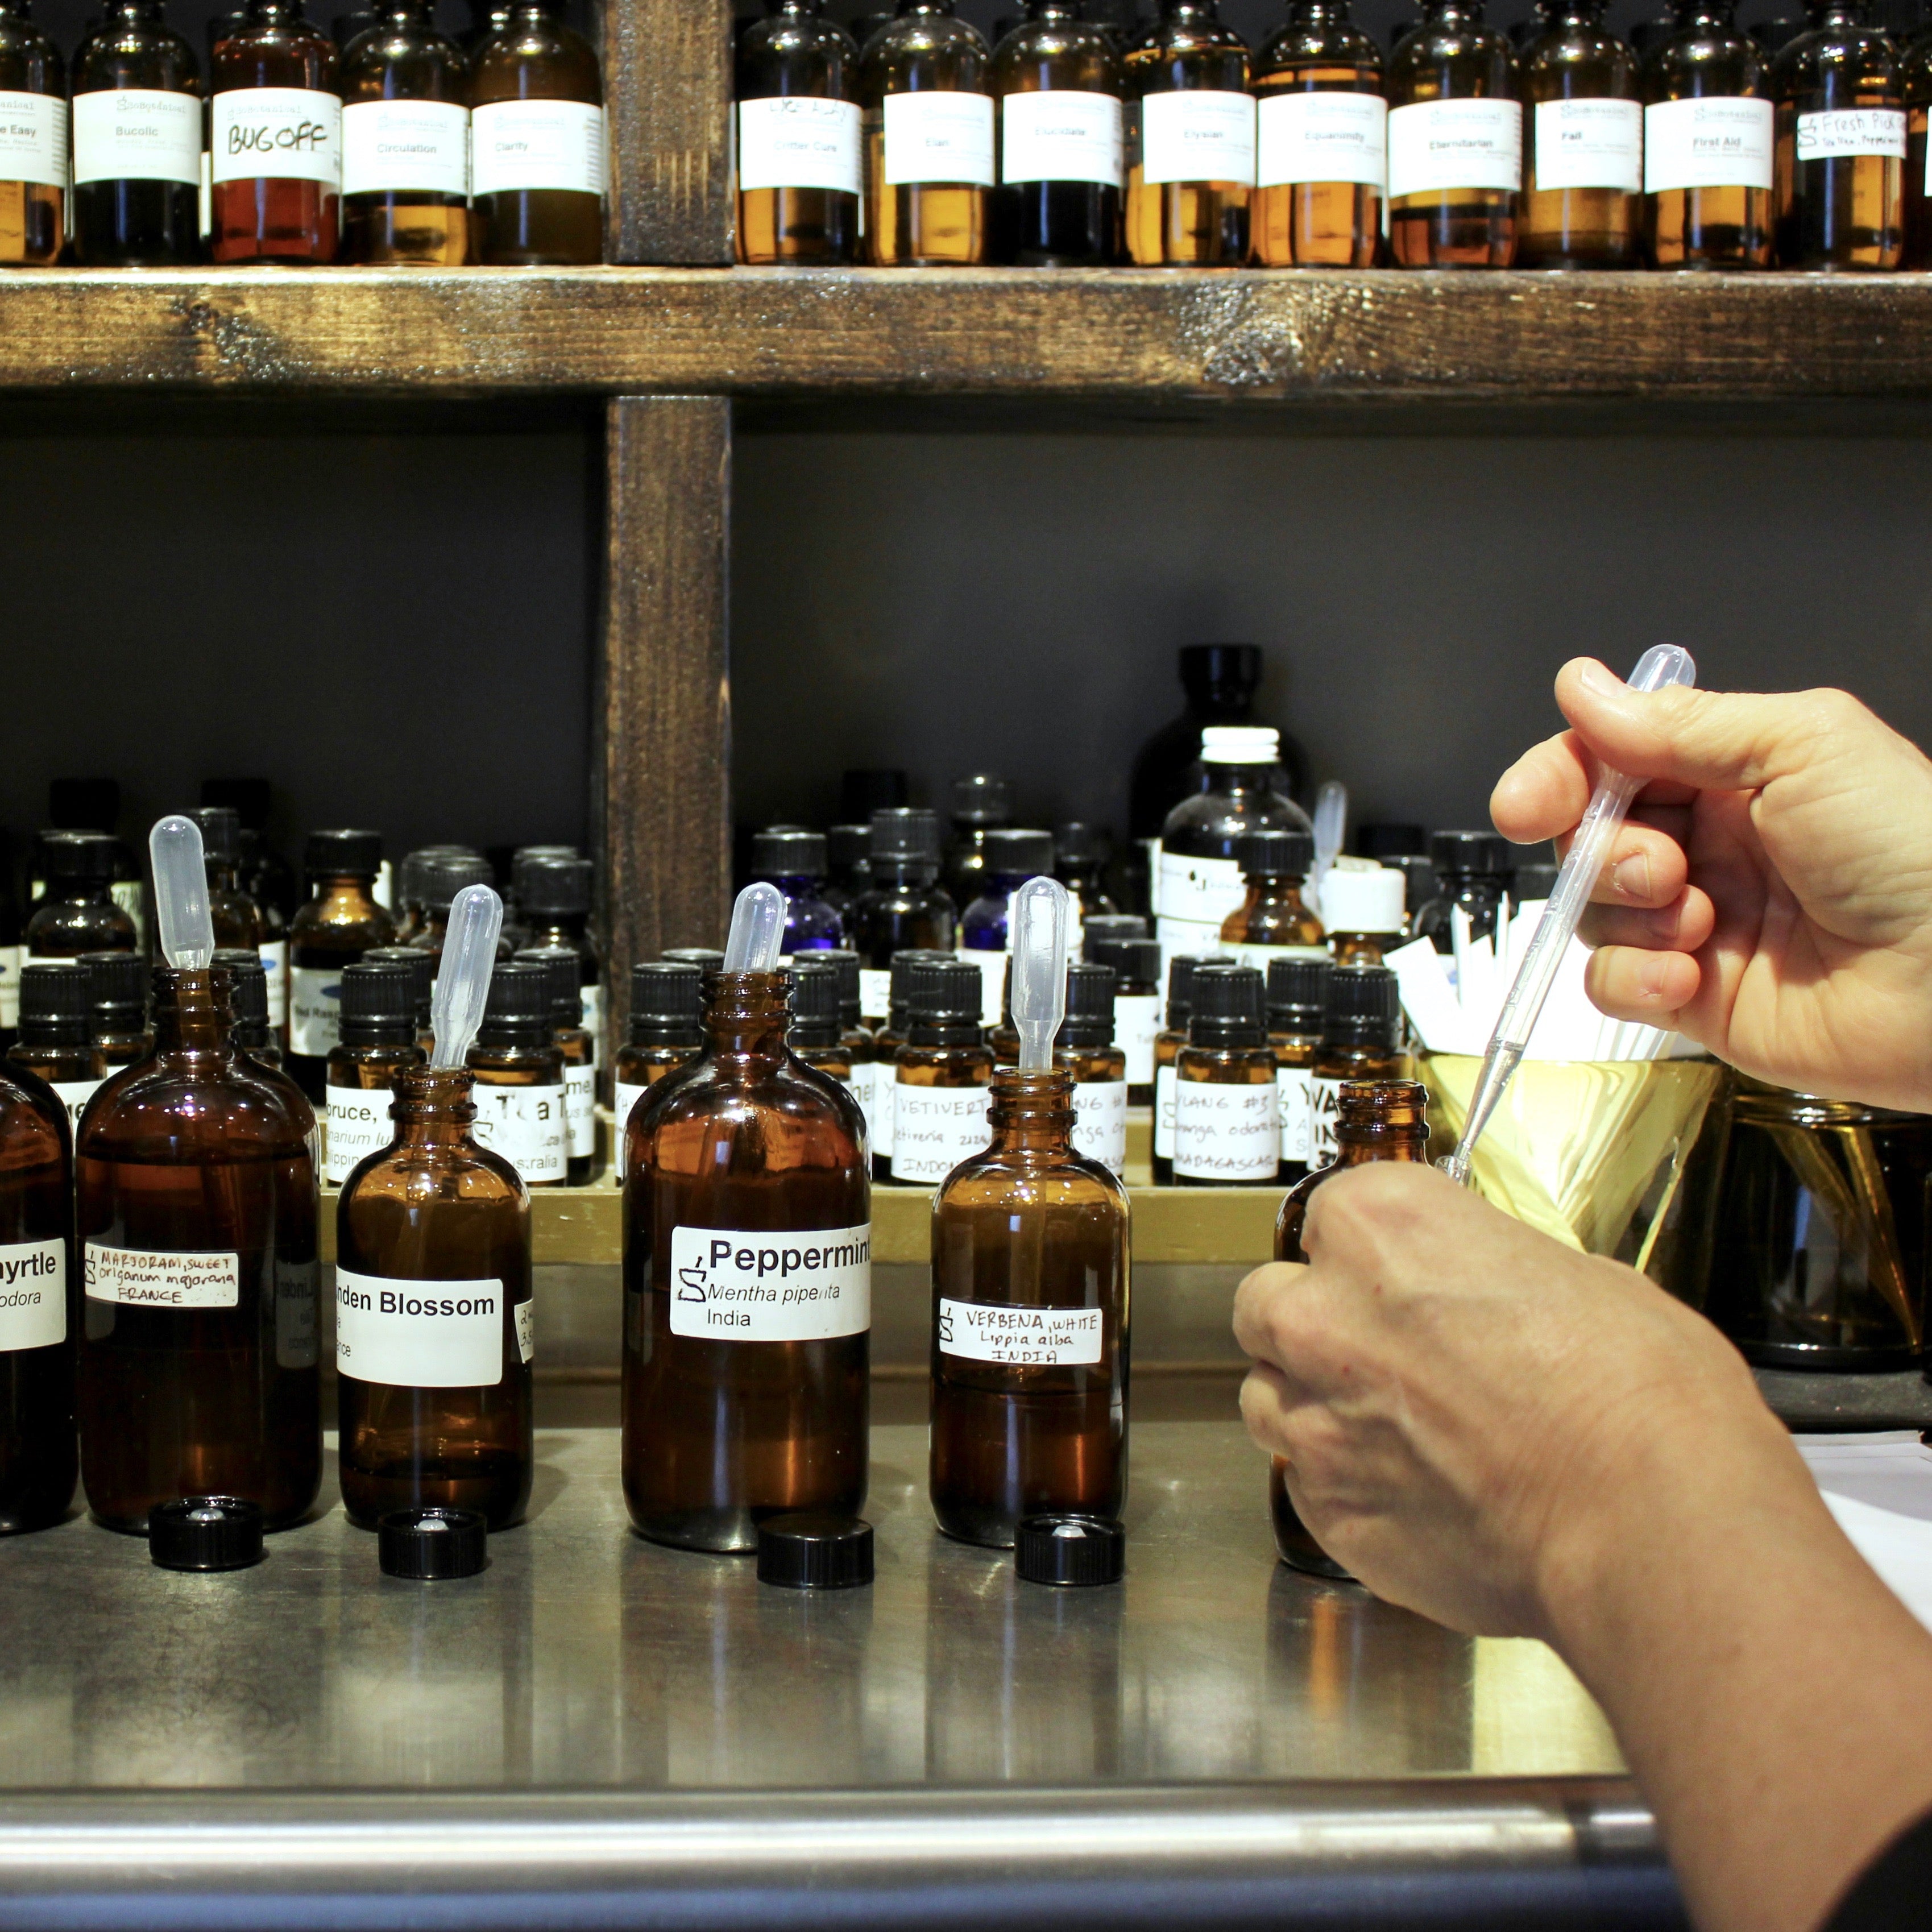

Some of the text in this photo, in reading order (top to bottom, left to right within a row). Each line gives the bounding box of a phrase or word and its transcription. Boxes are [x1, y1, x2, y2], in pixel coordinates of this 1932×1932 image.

[10, 125, 36, 138] Easy
[115, 126, 159, 136] Bucolic
[228, 124, 274, 155] BUG
[275, 120, 328, 152] OFF
[1561, 131, 1582, 140] Fall
[495, 141, 528, 153] Clarity
[1693, 136, 1743, 147] First Aid
[377, 143, 437, 154] Circulation
[118, 1287, 183, 1303] FRANCE
[707, 1283, 776, 1302] Mentha
[380, 1291, 495, 1317] Blossom
[707, 1308, 751, 1326] India
[1038, 1334, 1074, 1346] alba
[992, 1350, 1058, 1364] INDIA
